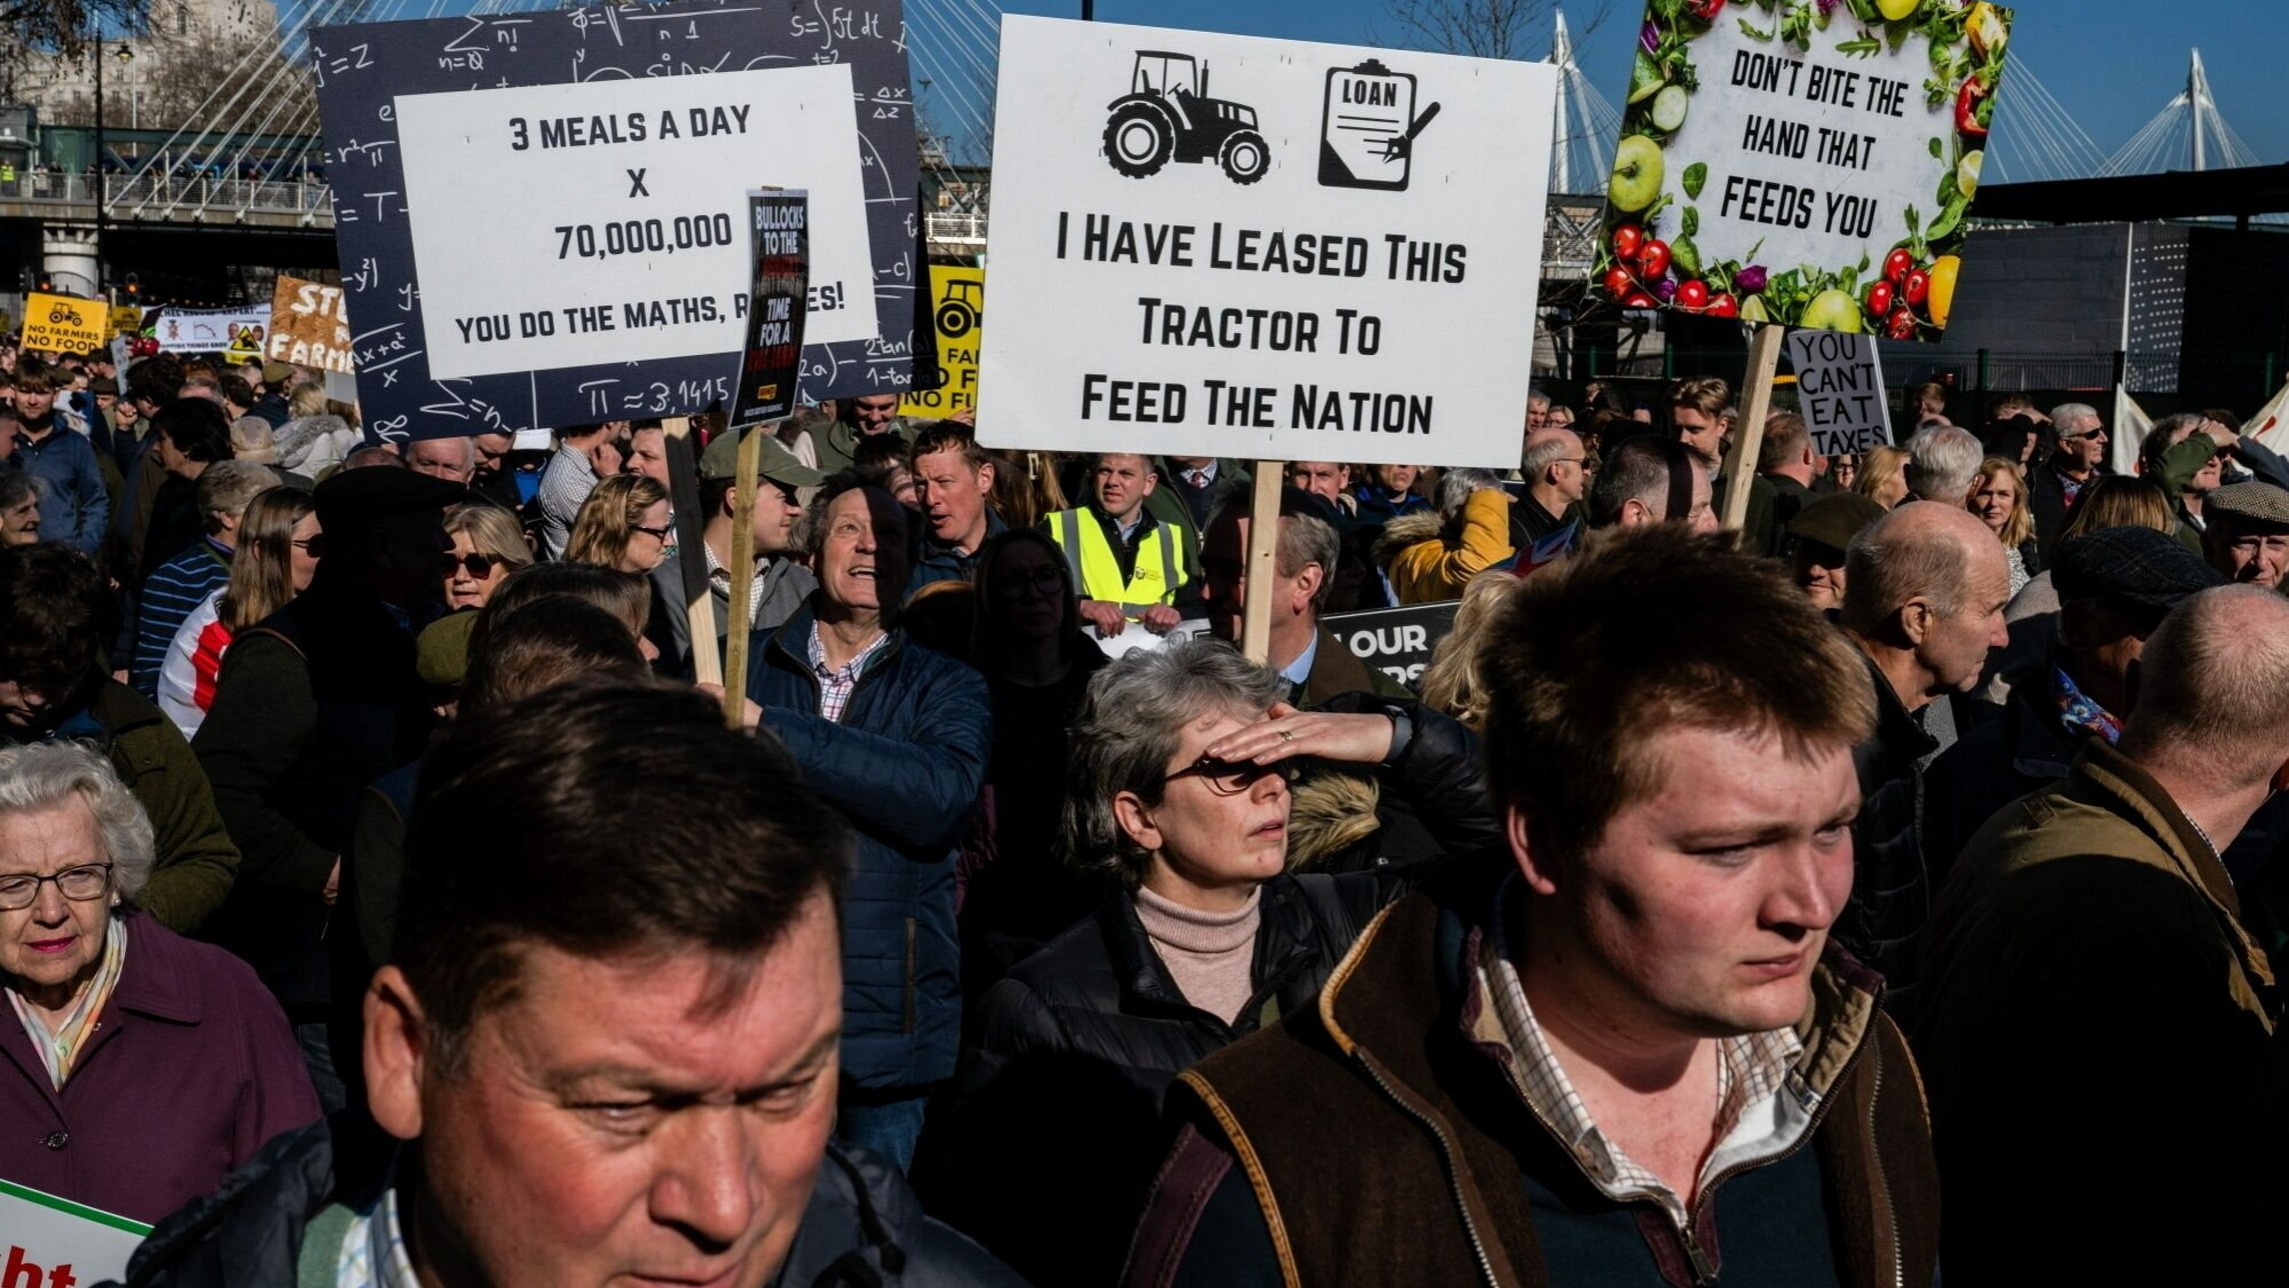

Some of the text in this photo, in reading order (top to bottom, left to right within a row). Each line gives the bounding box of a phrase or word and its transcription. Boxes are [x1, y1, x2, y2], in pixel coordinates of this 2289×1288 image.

[1343, 79, 1397, 107] LOAN
[1731, 49, 1909, 117] DON'T BITE THE
[509, 105, 750, 150] 3 MEALS A DAY
[1743, 115, 1876, 170] HAND THAT
[627, 168, 649, 198] X
[756, 206, 804, 230] BULLOCKS
[1721, 176, 1877, 238] FEEDS YOU
[555, 213, 732, 260] 70,000,000
[764, 231, 798, 254] TO THE
[1057, 212, 1467, 284] I HAVE LEASED THIS
[456, 315, 510, 343] YOU
[520, 311, 555, 338] DO
[563, 305, 615, 333] THE
[624, 297, 725, 326] MATHS,
[734, 281, 844, 318] RES!
[767, 298, 791, 321] TIME
[28, 325, 99, 340] NO FARMERS
[760, 321, 791, 347] FOR A
[1139, 298, 1381, 355] TRACTOR TO
[26, 335, 97, 352] NO FOOD
[1797, 333, 1856, 363] YOU
[1800, 363, 1874, 395] CAN'T
[904, 391, 942, 407] NO
[1082, 374, 1433, 434] FEED THE NATION
[1811, 395, 1873, 425] EAT
[1811, 425, 1888, 455] TAXES
[1350, 625, 1428, 658] OUR
[1, 1245, 77, 1288] ht
